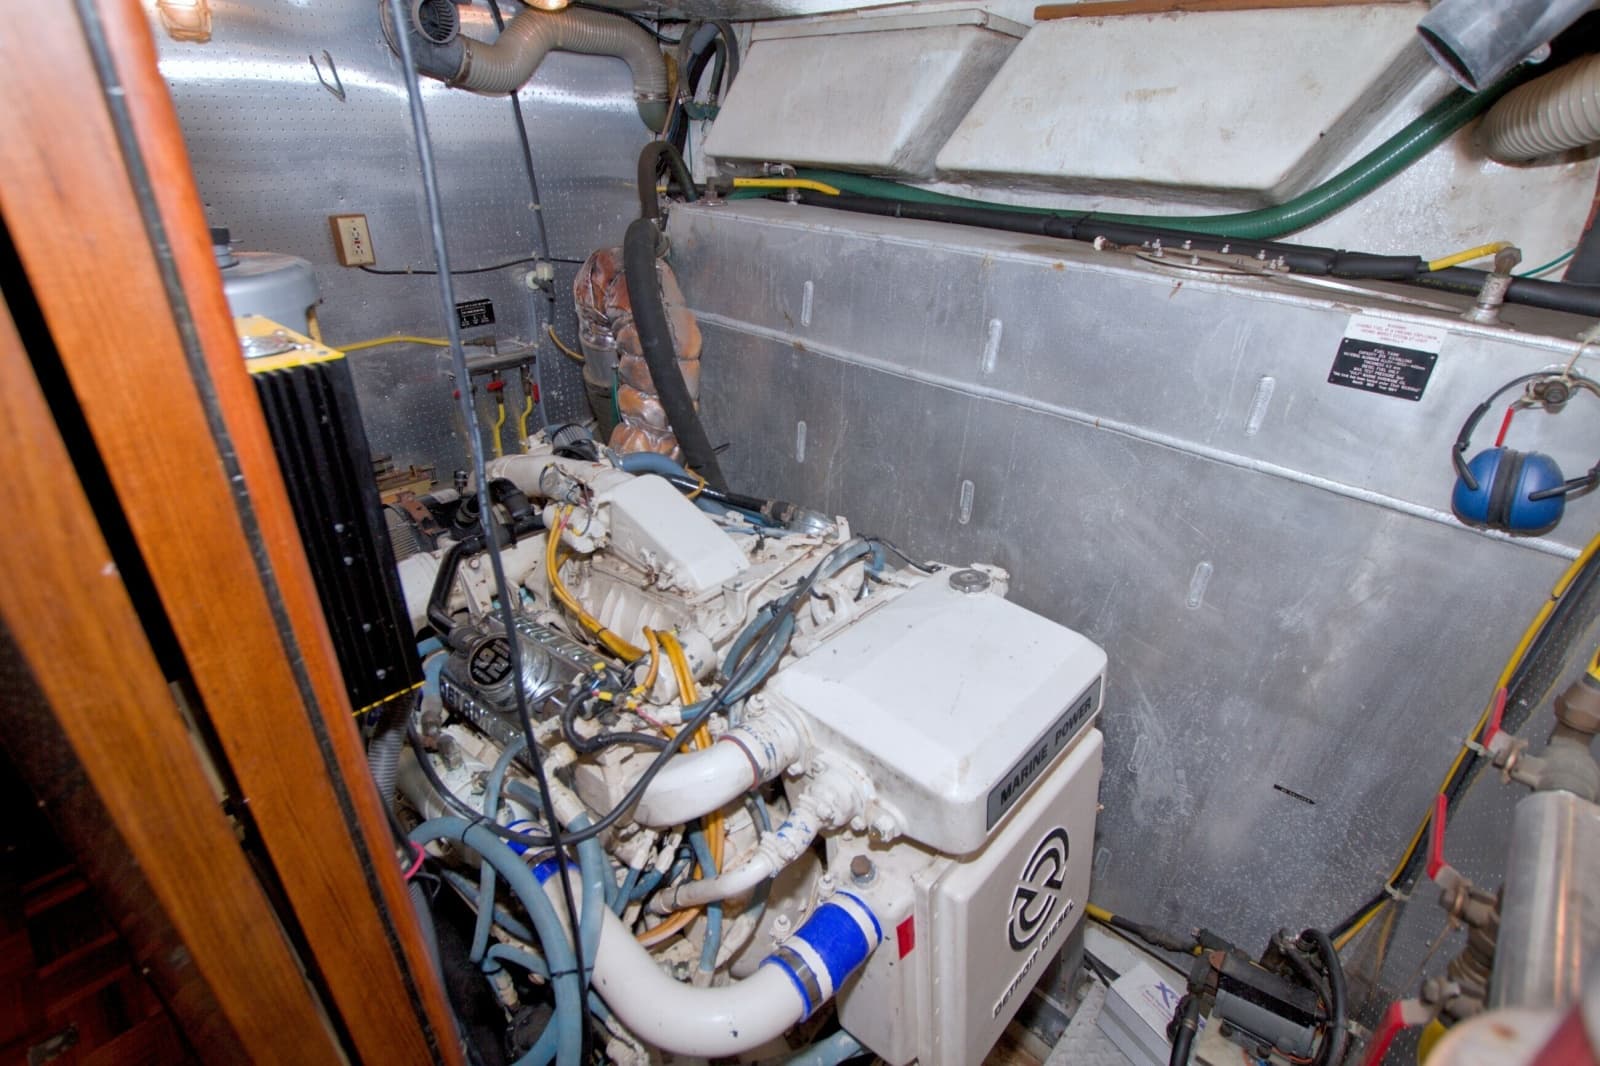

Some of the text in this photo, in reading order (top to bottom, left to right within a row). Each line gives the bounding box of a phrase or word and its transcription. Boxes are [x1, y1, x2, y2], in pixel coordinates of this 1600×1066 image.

[1000, 696, 1092, 805] MARINE POWER
[992, 899, 1075, 1018] DETROIT DIESEL
